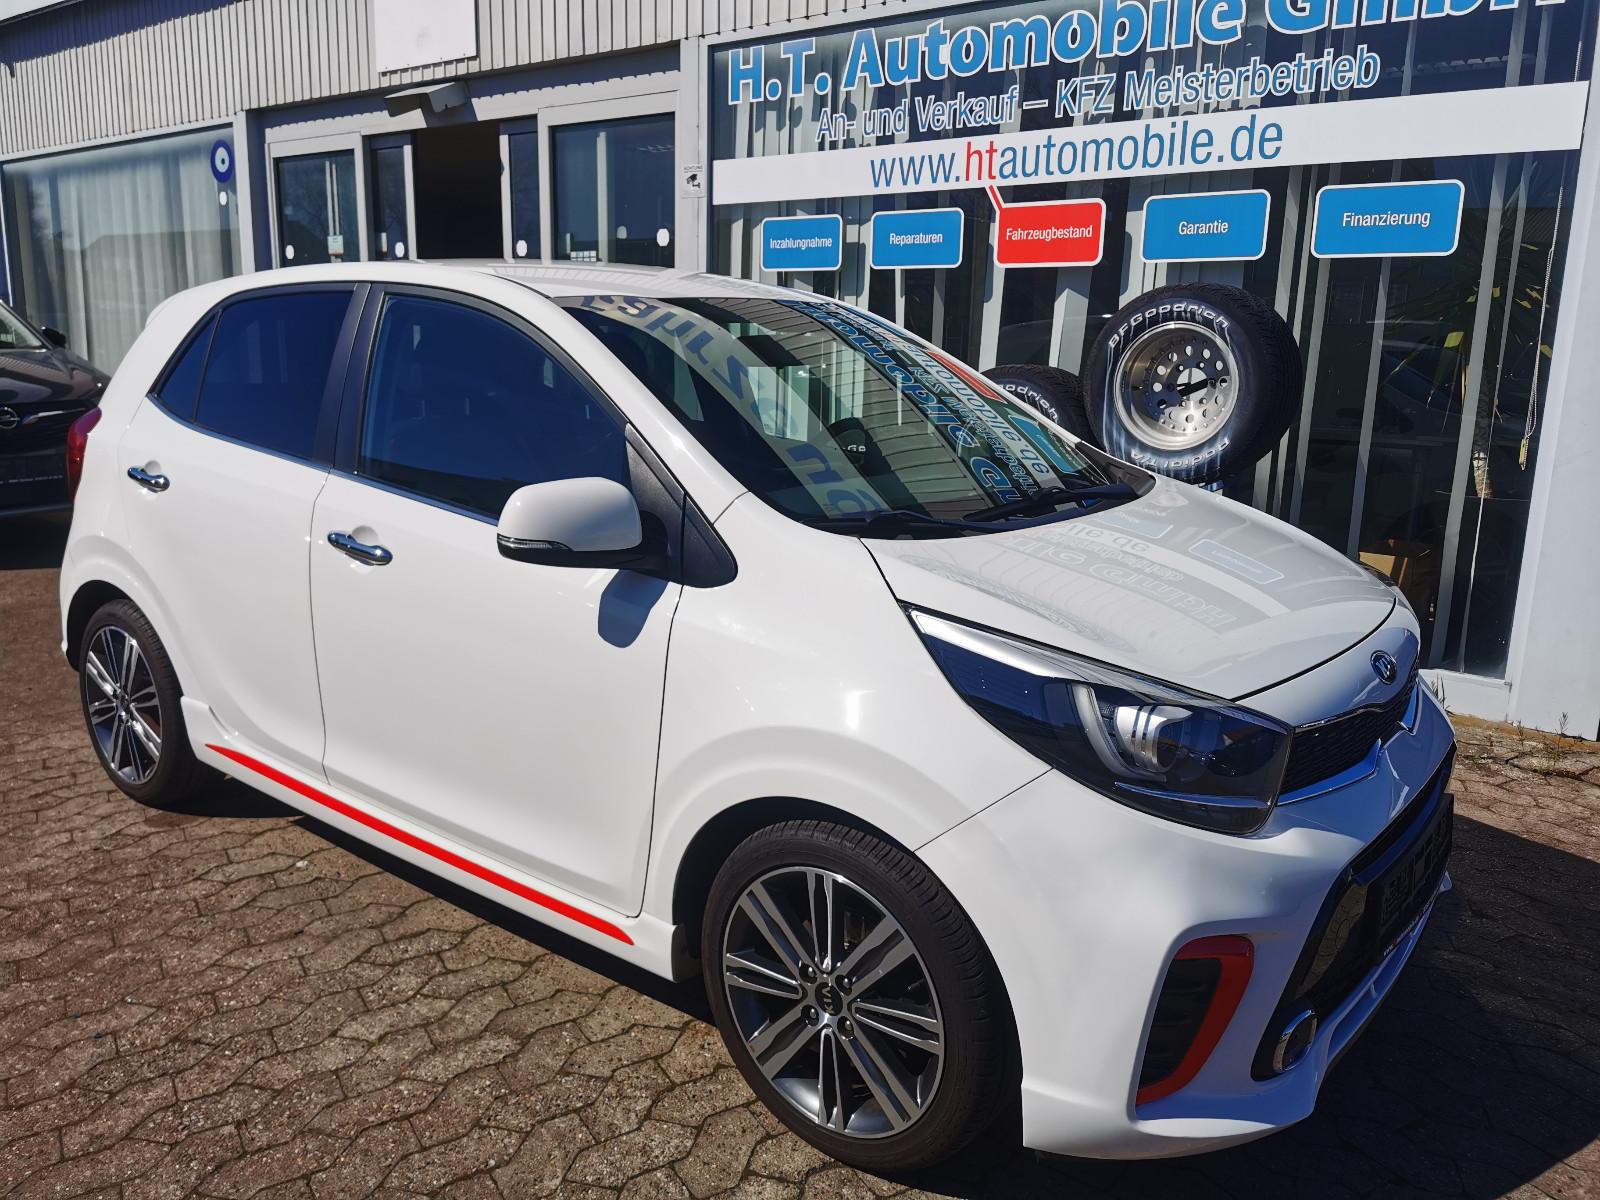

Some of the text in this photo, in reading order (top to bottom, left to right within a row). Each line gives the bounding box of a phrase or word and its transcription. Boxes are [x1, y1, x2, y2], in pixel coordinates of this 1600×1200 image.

[728, 39, 831, 105] H.T.
[841, 0, 1247, 90] Automobile
[815, 106, 857, 142] An-
[862, 98, 909, 138] und
[915, 84, 1020, 132] Verkauf
[1055, 73, 1116, 118] KFZ
[1123, 44, 1381, 111] Meisterbetrieb
[870, 114, 1283, 188] www.htautomobile.de
[1178, 219, 1229, 236] Garantie
[1342, 211, 1431, 229] Finanzierung
[889, 232, 943, 247] Reparaturen
[1006, 224, 1093, 242] Fahrzeugbestand
[769, 236, 833, 251] Inzahlungnahme
